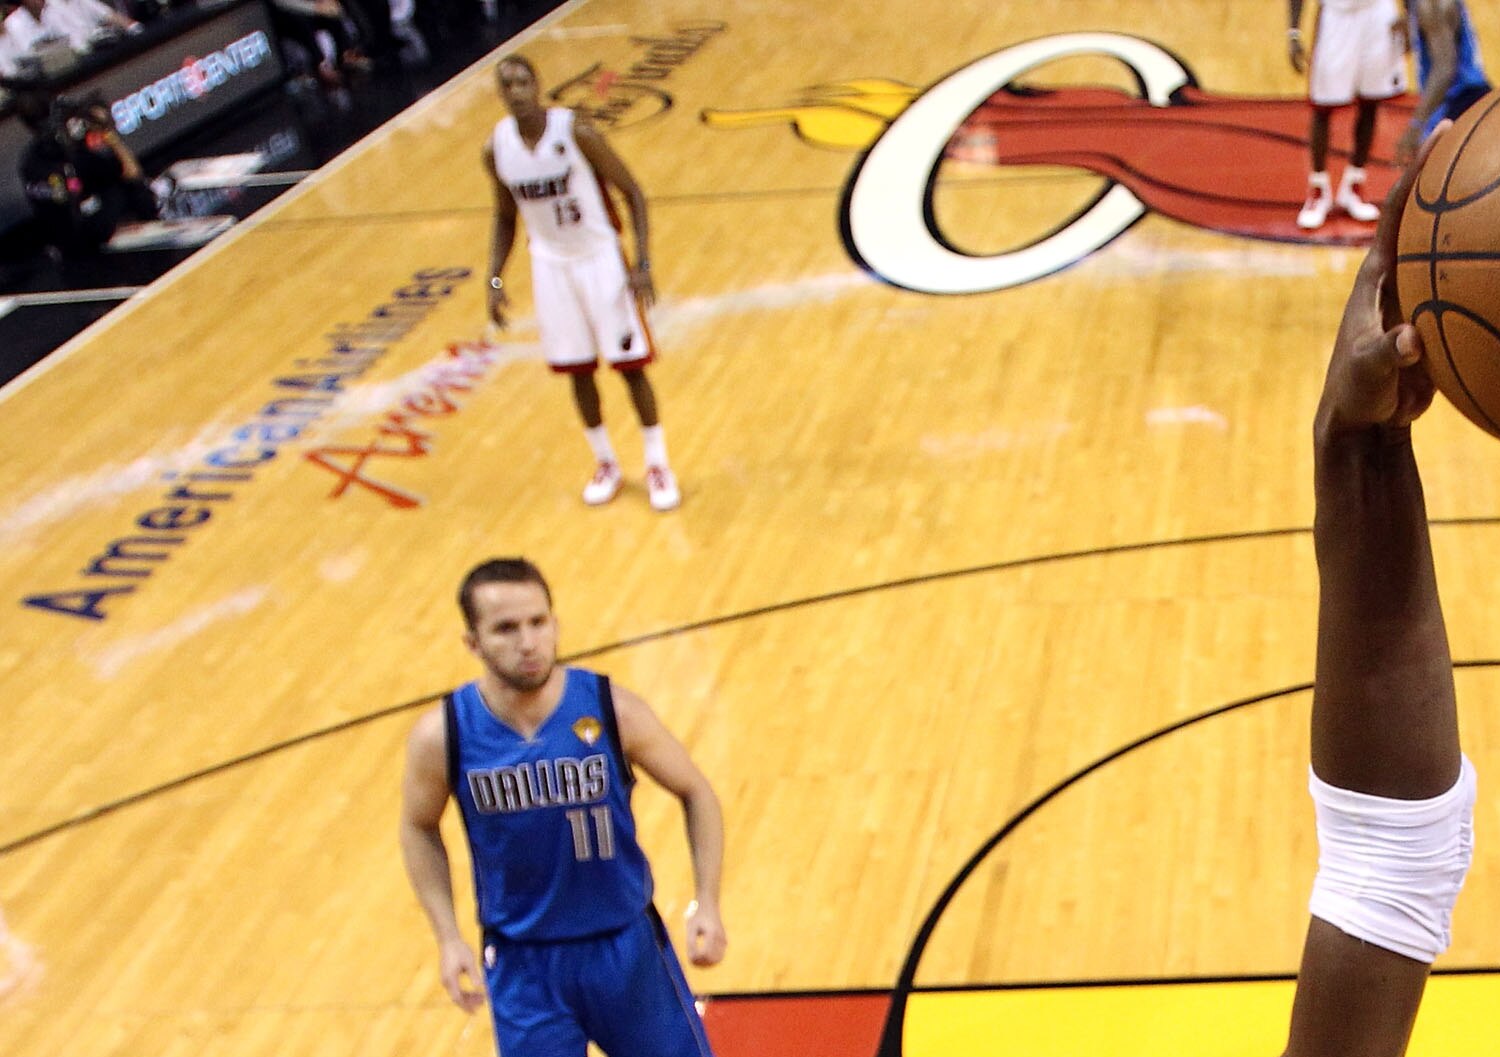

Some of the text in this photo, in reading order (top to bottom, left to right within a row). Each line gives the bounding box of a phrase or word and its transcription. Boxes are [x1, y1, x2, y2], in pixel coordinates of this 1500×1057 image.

[303, 337, 500, 510] Arena
[468, 754, 608, 814] DALLAS
[565, 806, 616, 862] 11
